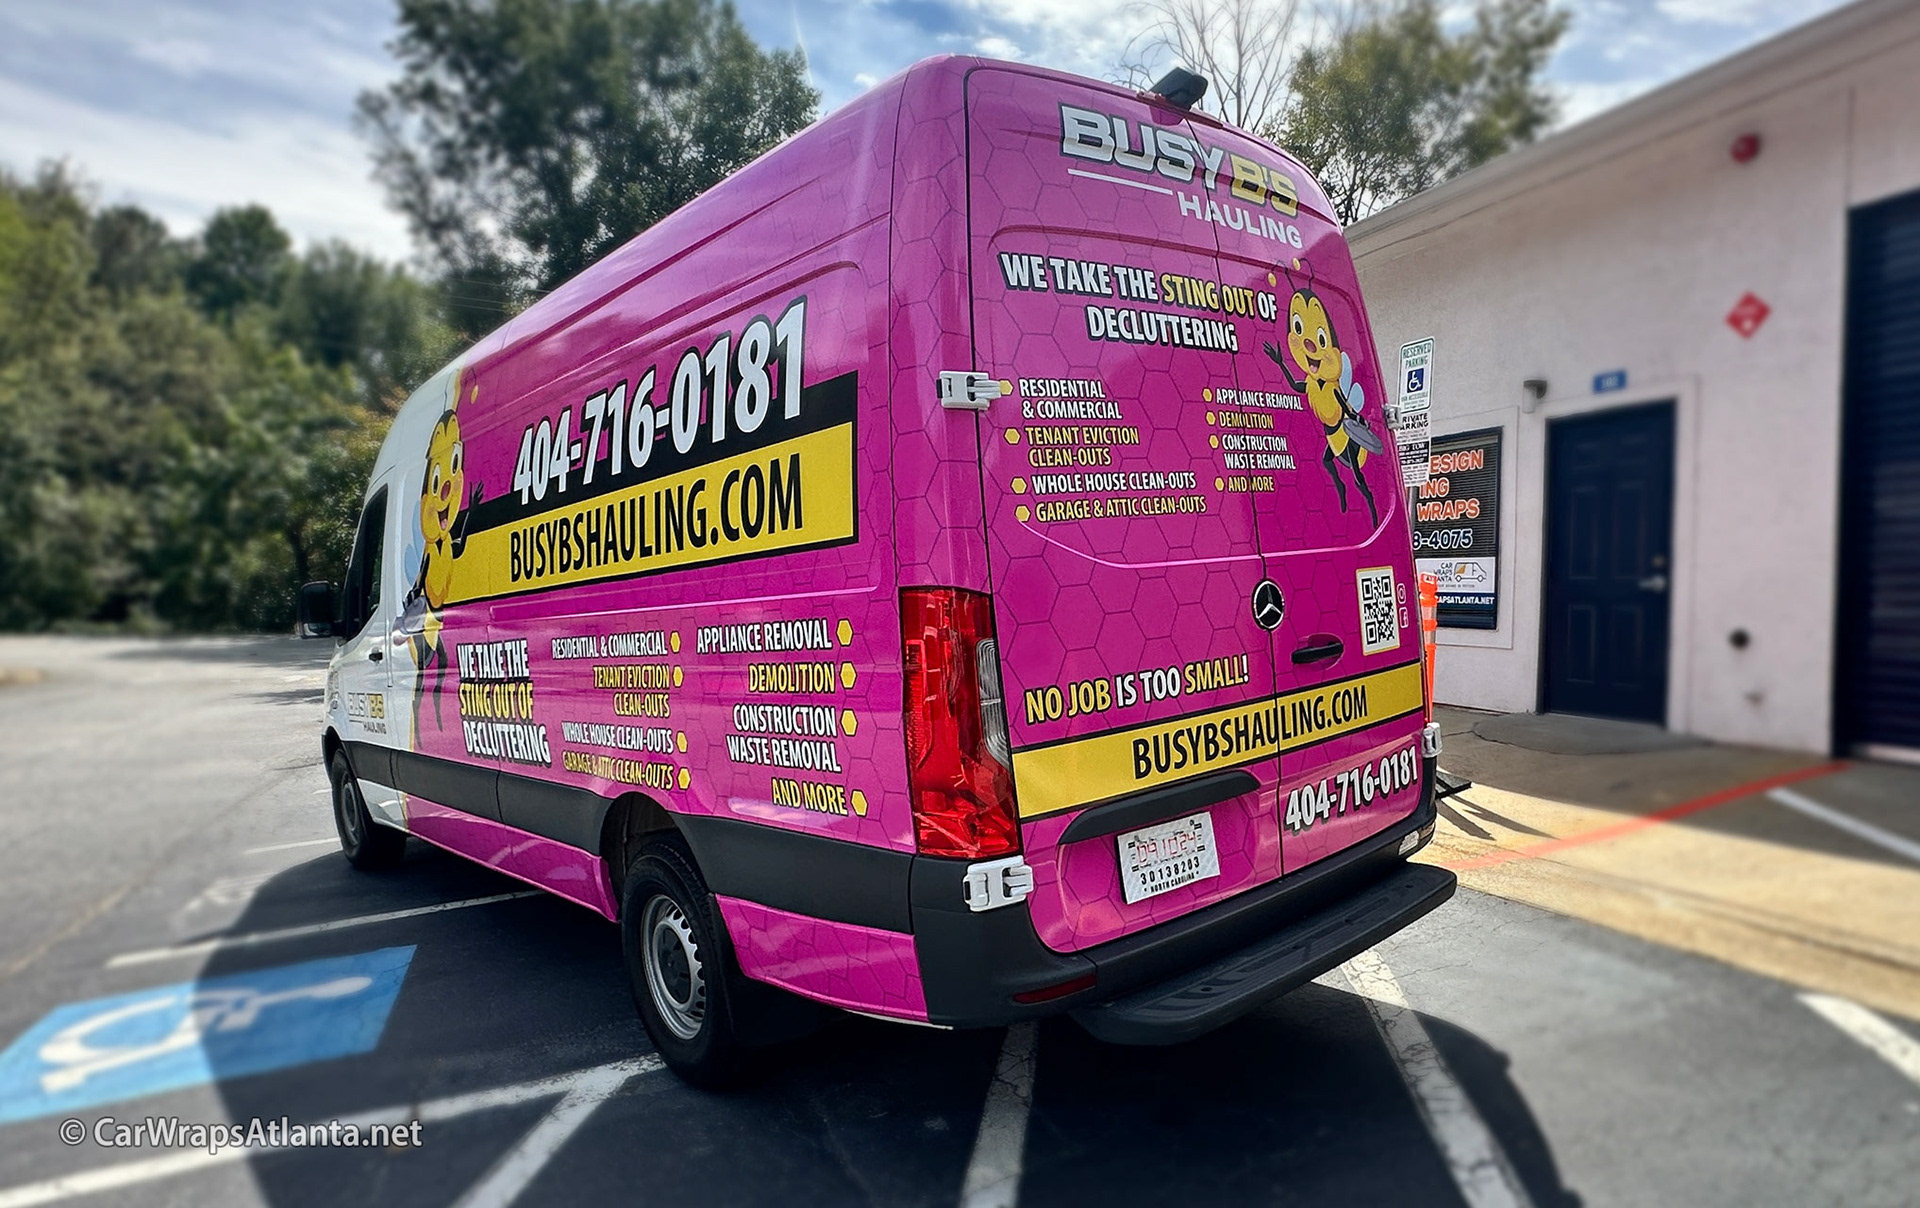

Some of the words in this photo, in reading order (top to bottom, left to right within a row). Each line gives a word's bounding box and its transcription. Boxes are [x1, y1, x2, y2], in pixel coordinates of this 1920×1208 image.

[1060, 103, 1226, 191] BUSY
[1177, 192, 1303, 248] HAULING
[1000, 253, 1048, 290] WE
[1050, 257, 1112, 295] TAKE
[1113, 266, 1159, 301] THE
[1161, 273, 1219, 310] STING
[1221, 285, 1255, 317] OUT
[1257, 292, 1277, 320] OF
[1086, 305, 1238, 352] DECLUTTERING
[1019, 379, 1106, 398] RESIDENTIAL
[1216, 388, 1265, 407] APPLIANCE
[1266, 393, 1303, 410] REMOVAL
[513, 299, 807, 505] 404-716-0181
[1022, 401, 1034, 419] &
[1037, 401, 1122, 419] COMMERCIAL
[1219, 411, 1274, 429] DEMOLITION
[1400, 420, 1429, 430] ARKING
[1402, 413, 1428, 423] RIVATE
[1025, 427, 1079, 445] TENANT
[1083, 427, 1139, 445] EVICTION
[1222, 434, 1287, 451] CONSTRUCTION
[1029, 448, 1111, 467] CLEAN-OUTS
[1224, 453, 1256, 469] WASTE
[1256, 454, 1296, 470] REMOVAL
[1429, 449, 1484, 475] ESIGN
[1032, 474, 1082, 494] WHOLE
[1085, 473, 1127, 492] HOUSE
[1129, 472, 1196, 490] CLEAN-OUTS
[1228, 477, 1247, 492] AND
[1249, 477, 1275, 491] MORE
[1419, 477, 1449, 499] ING
[510, 453, 804, 583] BUSYBSHAULING.COM
[1035, 501, 1091, 522] GARAGE
[1093, 499, 1103, 517] &
[1107, 498, 1139, 516] ATTIC
[1141, 496, 1207, 515] CLEAN-OUTS
[1417, 498, 1480, 522] WRAPS
[1412, 528, 1473, 550] 8-4075
[1438, 595, 1495, 605] APSATLANTA.NET
[552, 637, 599, 658] RESIDENTIAL
[601, 636, 608, 657] &
[608, 631, 668, 657] COMMERCIAL
[697, 623, 762, 653] APPLIANCE
[764, 619, 833, 650] REMOVAL
[457, 643, 475, 678] WE
[475, 641, 506, 678] TAKE
[505, 639, 530, 678] THE
[593, 666, 626, 688] TENANT
[627, 665, 670, 688] EVICTION
[749, 663, 835, 692] DEMOLITION
[1025, 688, 1063, 725] NO
[1068, 679, 1111, 717] JOB
[1116, 675, 1138, 708] IS
[1141, 668, 1181, 703] TOO
[1185, 654, 1249, 693] SMALL!
[459, 681, 491, 718] STING
[492, 682, 516, 719] OUT
[518, 682, 534, 720] OF
[614, 693, 671, 717] CLEAN-OUTS
[733, 704, 837, 736] CONSTRUCTION
[1132, 684, 1369, 780] BUSYBSHAULING.COM
[462, 720, 552, 764] DECLUTTERING
[561, 721, 590, 744] WHOLE
[590, 723, 616, 747] HOUSE
[617, 726, 674, 754] CLEAN-OUTS
[726, 735, 771, 764] WASTE
[771, 739, 842, 773] REMOVAL
[562, 751, 592, 773] GARAGE
[592, 756, 598, 776] &
[597, 756, 616, 780] ATTIC
[616, 759, 673, 790] CLEAN-OUTS
[772, 778, 801, 808] AND
[802, 782, 848, 816] MORE
[1285, 745, 1418, 832] 404-716-0181
[1140, 856, 1200, 885] 30138203
[1151, 881, 1170, 893] NORTH
[1170, 872, 1195, 888] CAROLINA
